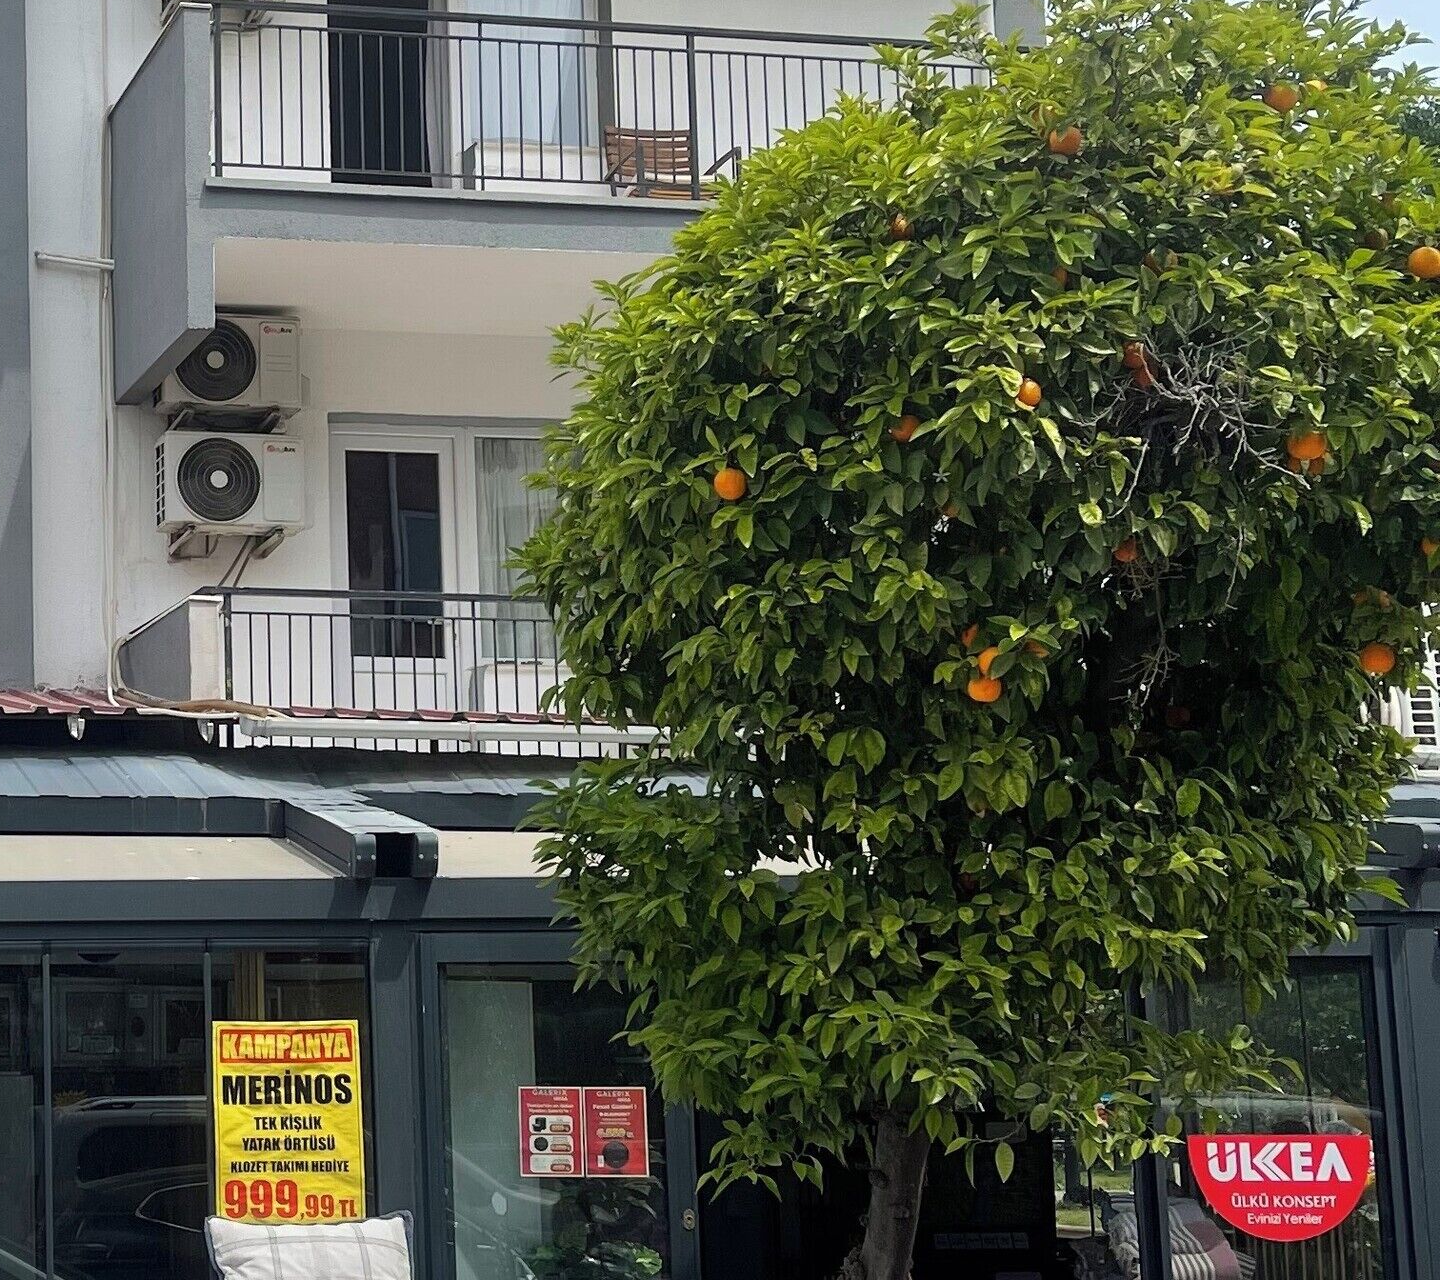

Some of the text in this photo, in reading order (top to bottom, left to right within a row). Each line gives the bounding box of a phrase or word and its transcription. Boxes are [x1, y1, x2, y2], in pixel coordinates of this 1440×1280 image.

[222, 1032, 351, 1060] KAMPANYA
[221, 1070, 353, 1105] MERİNOS
[253, 1114, 323, 1133] TEK KİŞLİK
[242, 1134, 335, 1151] YATAK ÖRTÜSÜ
[230, 1159, 350, 1173] KLOZET TAKIMI HEDİYE
[339, 1199, 358, 1218] TL
[1231, 1193, 1337, 1208] ÜLKÜ KONSEPT
[1247, 1213, 1324, 1225] Evinizi Yeniler
